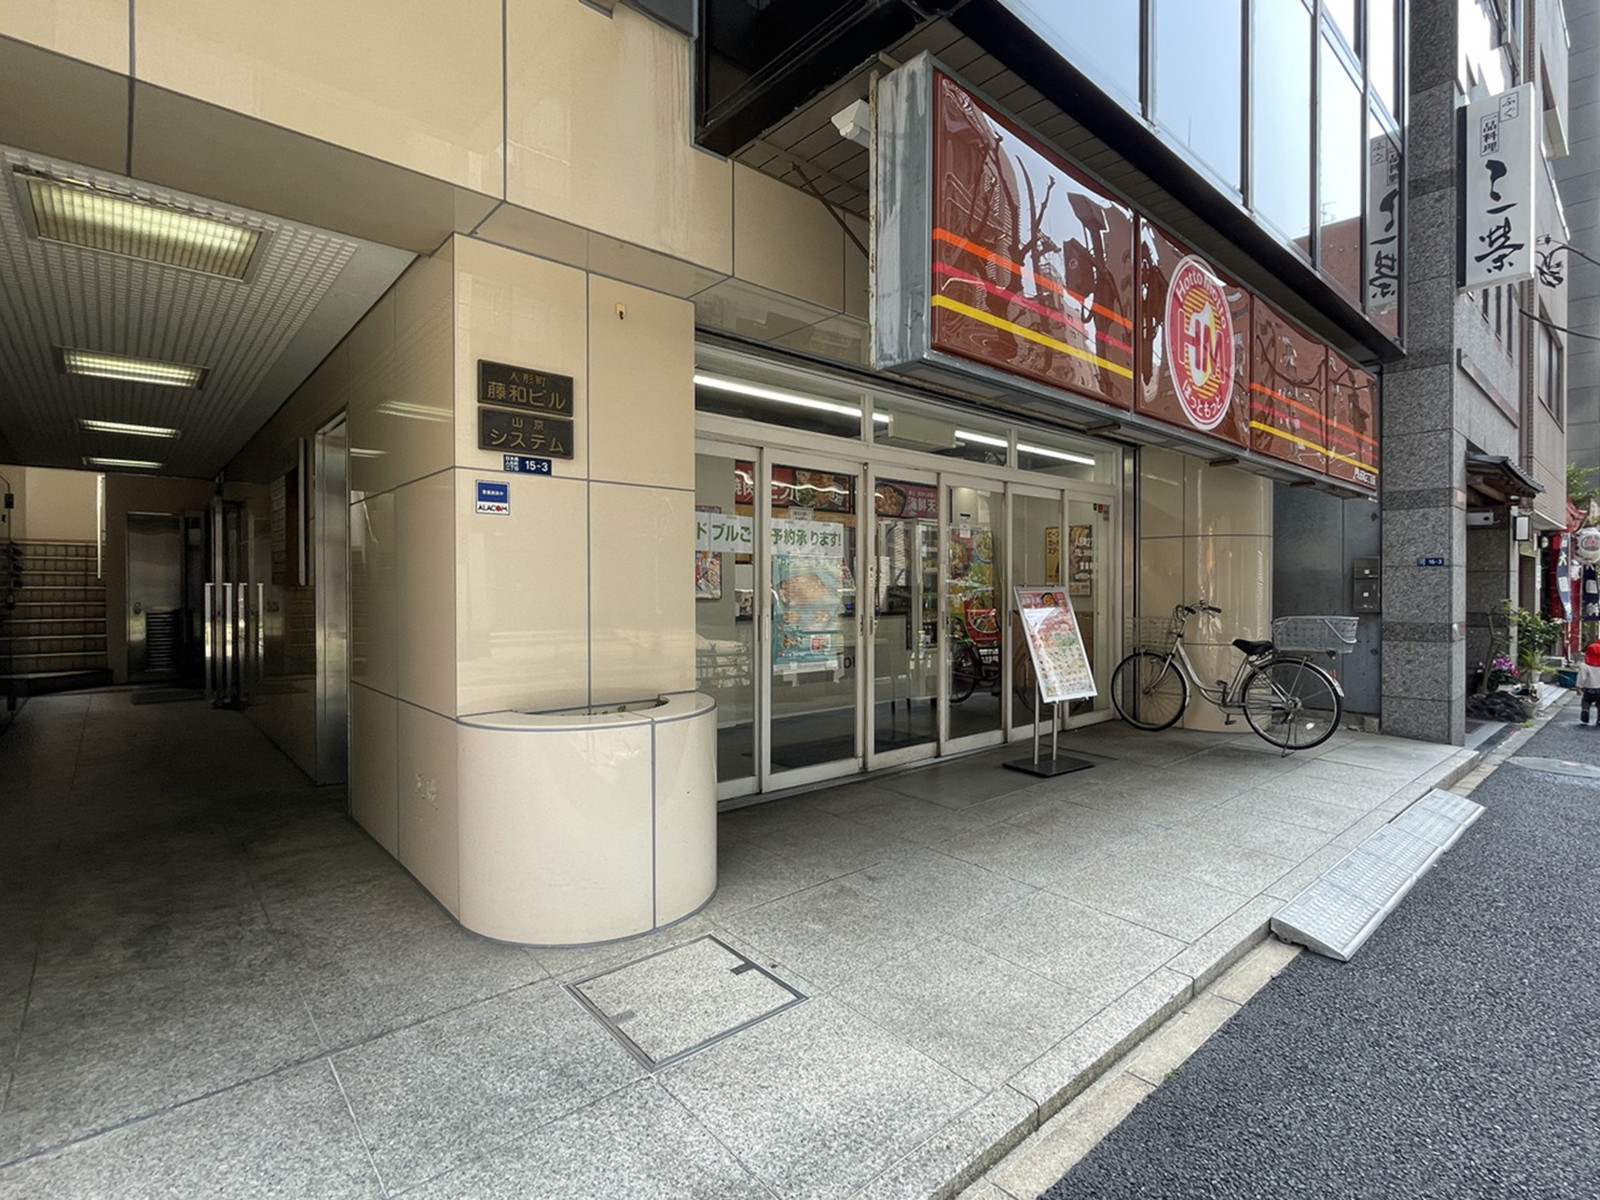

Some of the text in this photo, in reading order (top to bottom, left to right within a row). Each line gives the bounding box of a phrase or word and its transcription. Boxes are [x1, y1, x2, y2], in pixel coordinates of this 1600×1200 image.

[1176, 271, 1203, 302] Hotto
[510, 371, 546, 387] 人形町
[487, 381, 566, 409] 藤和ビル
[1182, 379, 1223, 418] ほっともっと
[490, 428, 565, 453] システム
[525, 460, 549, 472] 15-3
